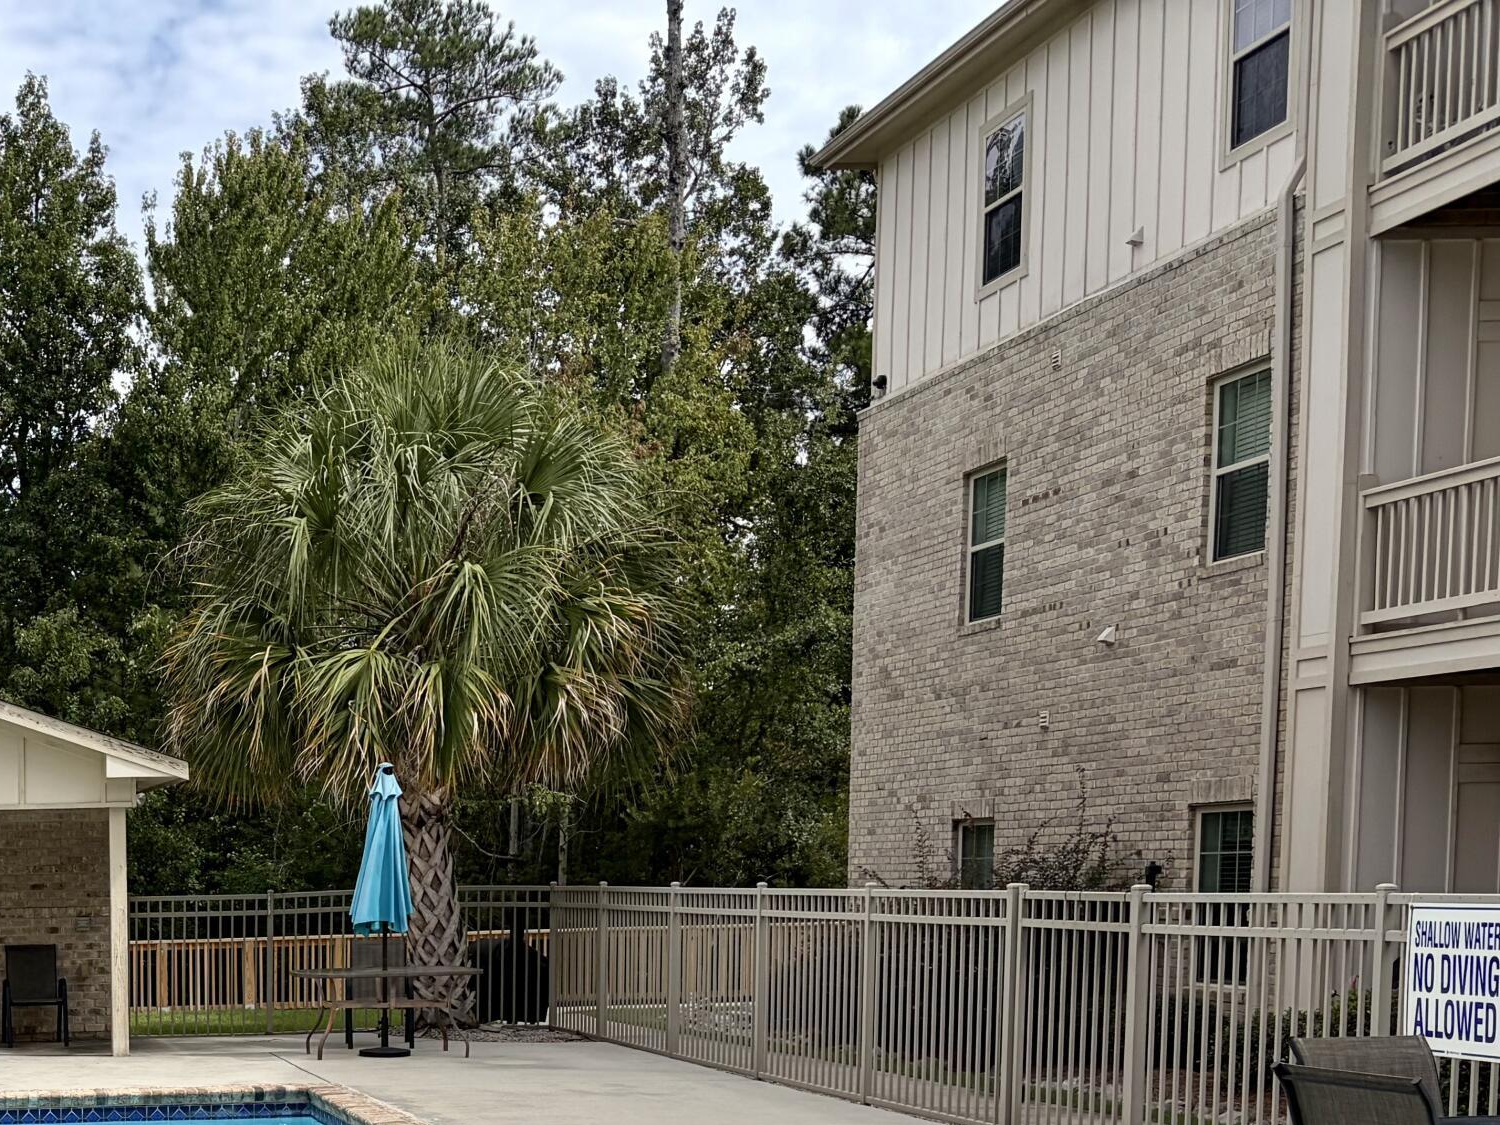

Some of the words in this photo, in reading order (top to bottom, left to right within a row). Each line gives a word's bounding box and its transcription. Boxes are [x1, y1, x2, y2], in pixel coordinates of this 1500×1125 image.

[1415, 920, 1461, 949] SHALLOW
[1464, 921, 1500, 950] WATER
[1413, 953, 1435, 993] NO
[1440, 954, 1500, 998] DIVING
[1413, 997, 1497, 1044] ALLOWED
